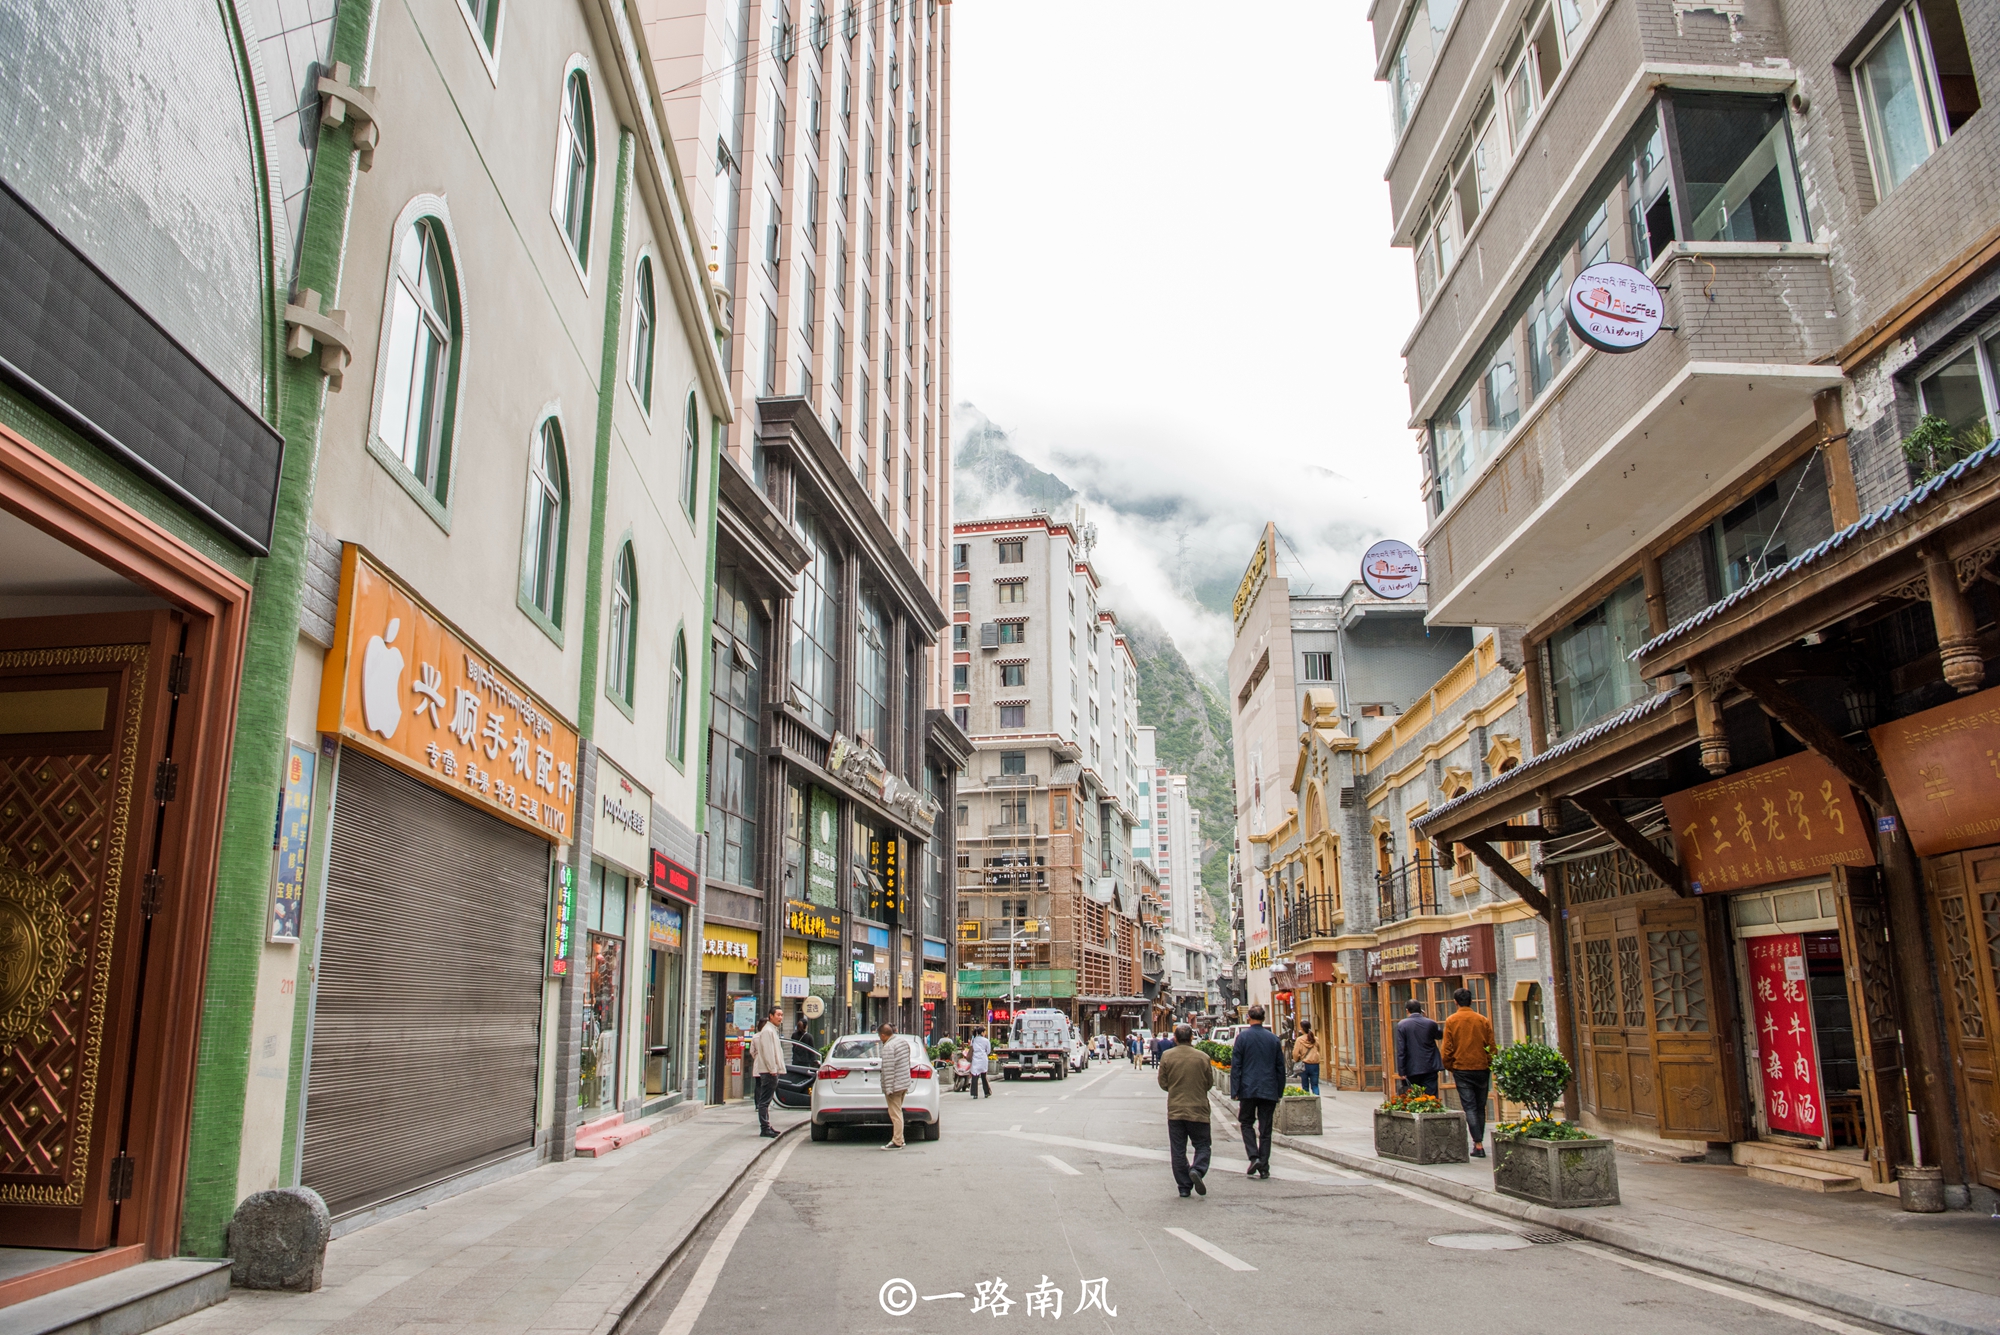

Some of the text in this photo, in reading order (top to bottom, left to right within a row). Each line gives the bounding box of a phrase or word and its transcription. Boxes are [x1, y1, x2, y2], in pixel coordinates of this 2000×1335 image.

[1611, 298, 1658, 319] Aicoffee
[412, 661, 575, 806] 兴顺手机配件
[464, 761, 491, 793] 苹果
[494, 779, 517, 808] 华为
[518, 793, 540, 821] 三星
[542, 803, 566, 833] VIVO
[1682, 779, 1845, 861] 丁三哥老字号
[1945, 825, 1964, 840] BAN
[1964, 819, 1990, 837] BIAN
[1741, 855, 1788, 879] 牦牛肉汤
[1752, 942, 1799, 959] 丁三哥老字号
[280, 979, 294, 995] 211
[1757, 975, 1790, 1119] 牦牛杂汤
[1781, 979, 1816, 1124] 牦牛肉汤
